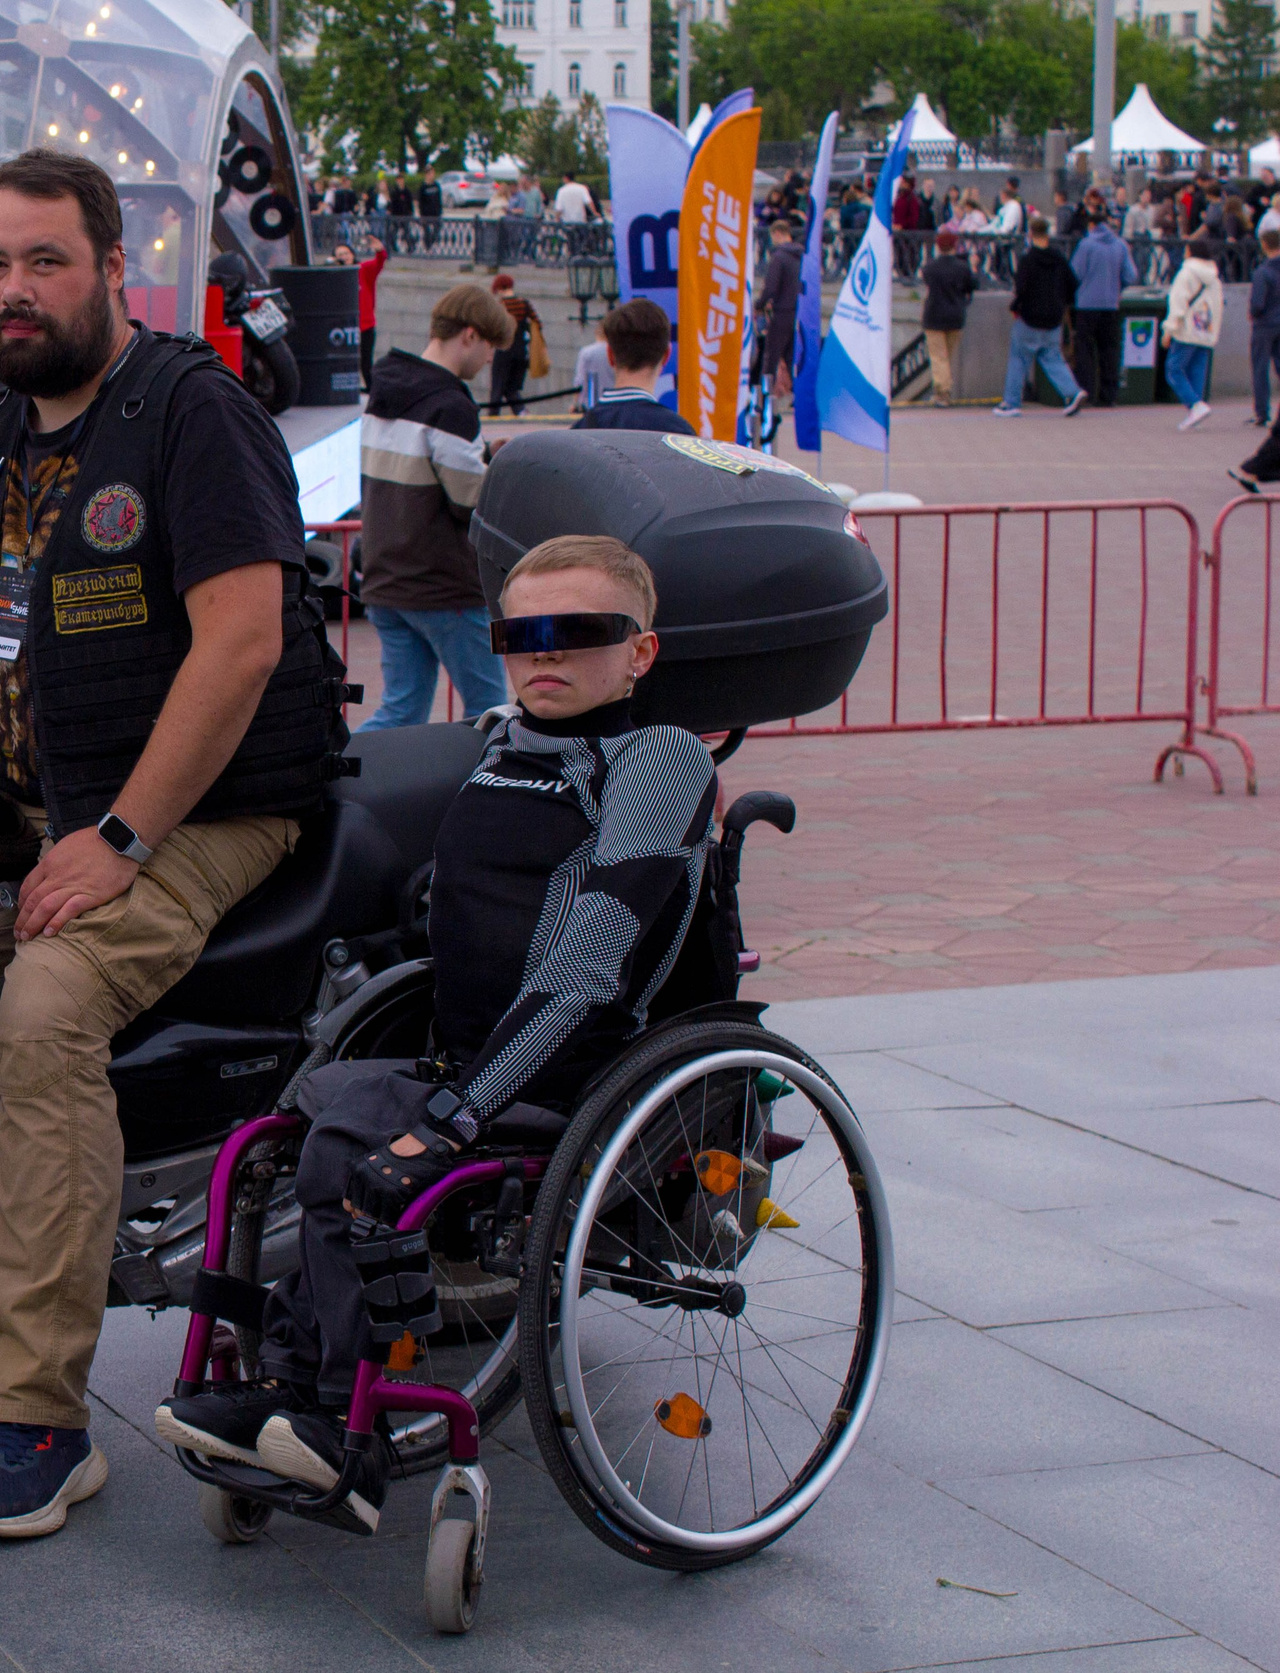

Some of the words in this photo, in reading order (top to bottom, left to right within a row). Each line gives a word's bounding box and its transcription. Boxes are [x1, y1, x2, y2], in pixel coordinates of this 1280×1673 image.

[697, 180, 717, 259] УРАЛ
[698, 190, 742, 440] ИЖЕНИЕ
[56, 572, 138, 597] Президент
